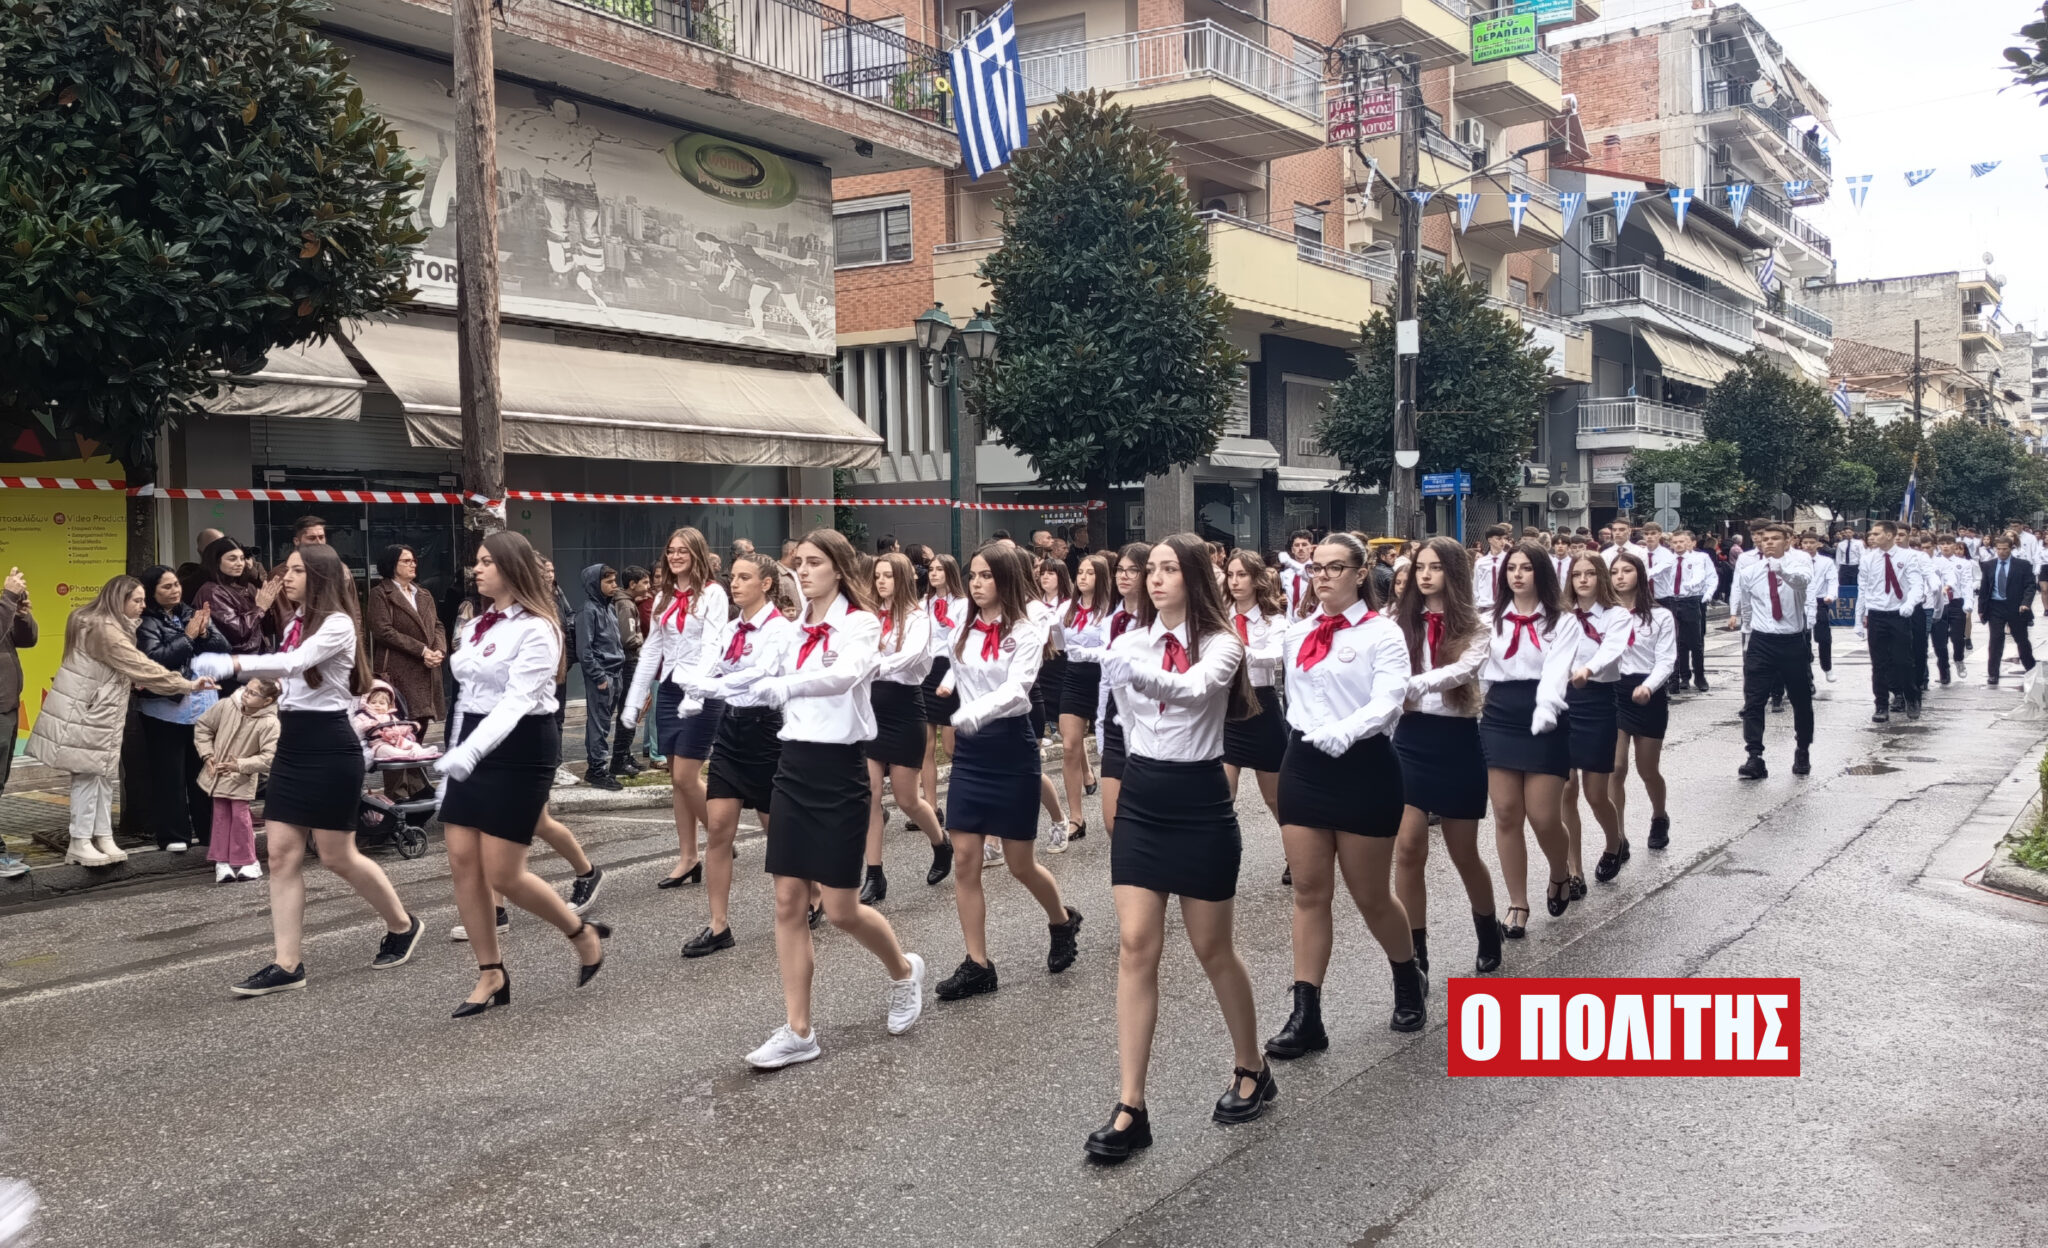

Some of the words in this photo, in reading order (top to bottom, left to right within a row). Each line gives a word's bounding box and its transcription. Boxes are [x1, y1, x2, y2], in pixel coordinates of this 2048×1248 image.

[1476, 26, 1531, 43] ΘΕΡΑΠΕΙΑ
[1330, 121, 1393, 142] ΚΑΡΔΙΛΟΓΟΣ
[697, 165, 742, 198] project
[404, 259, 459, 284] TOR
[1620, 486, 1631, 499] P
[67, 514, 91, 522] Video
[93, 514, 127, 522] Product
